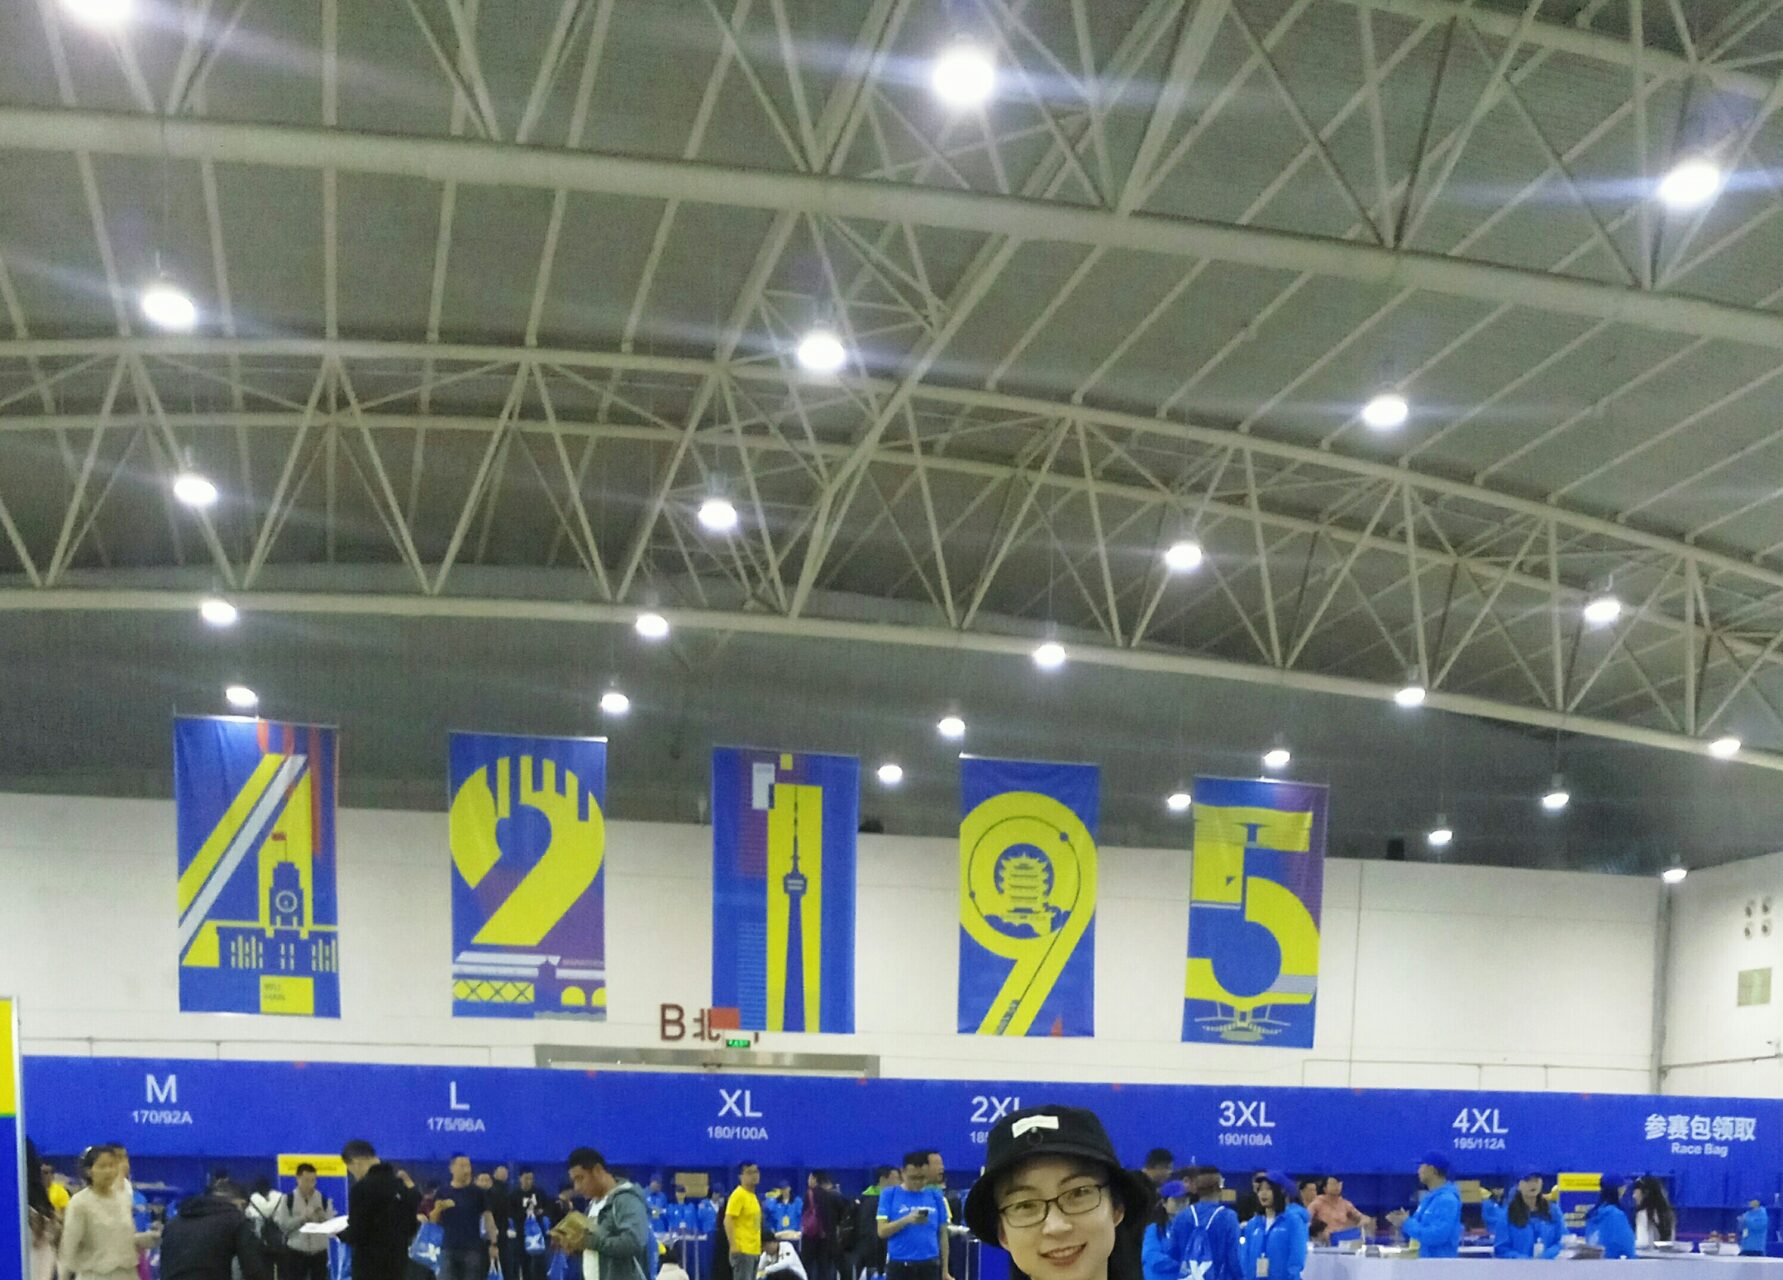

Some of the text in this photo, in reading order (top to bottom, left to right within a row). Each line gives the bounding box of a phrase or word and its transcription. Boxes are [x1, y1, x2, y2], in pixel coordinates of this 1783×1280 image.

[449, 755, 606, 946] 2
[959, 791, 1098, 1036] 9
[1185, 803, 1320, 1004] 5
[146, 1074, 177, 1104] M
[449, 1081, 470, 1110] L
[718, 1088, 763, 1118] XL
[132, 1110, 193, 1124] 170/92A
[1218, 1100, 1276, 1128] 3XL
[1452, 1107, 1509, 1134] 4XL
[1644, 1113, 1757, 1141] 参赛包领取
[707, 1126, 769, 1140] 180/100A
[1218, 1133, 1273, 1146] 190/108A
[1453, 1137, 1506, 1150] 195/112A
[1671, 1142, 1729, 1158] Race Bag
